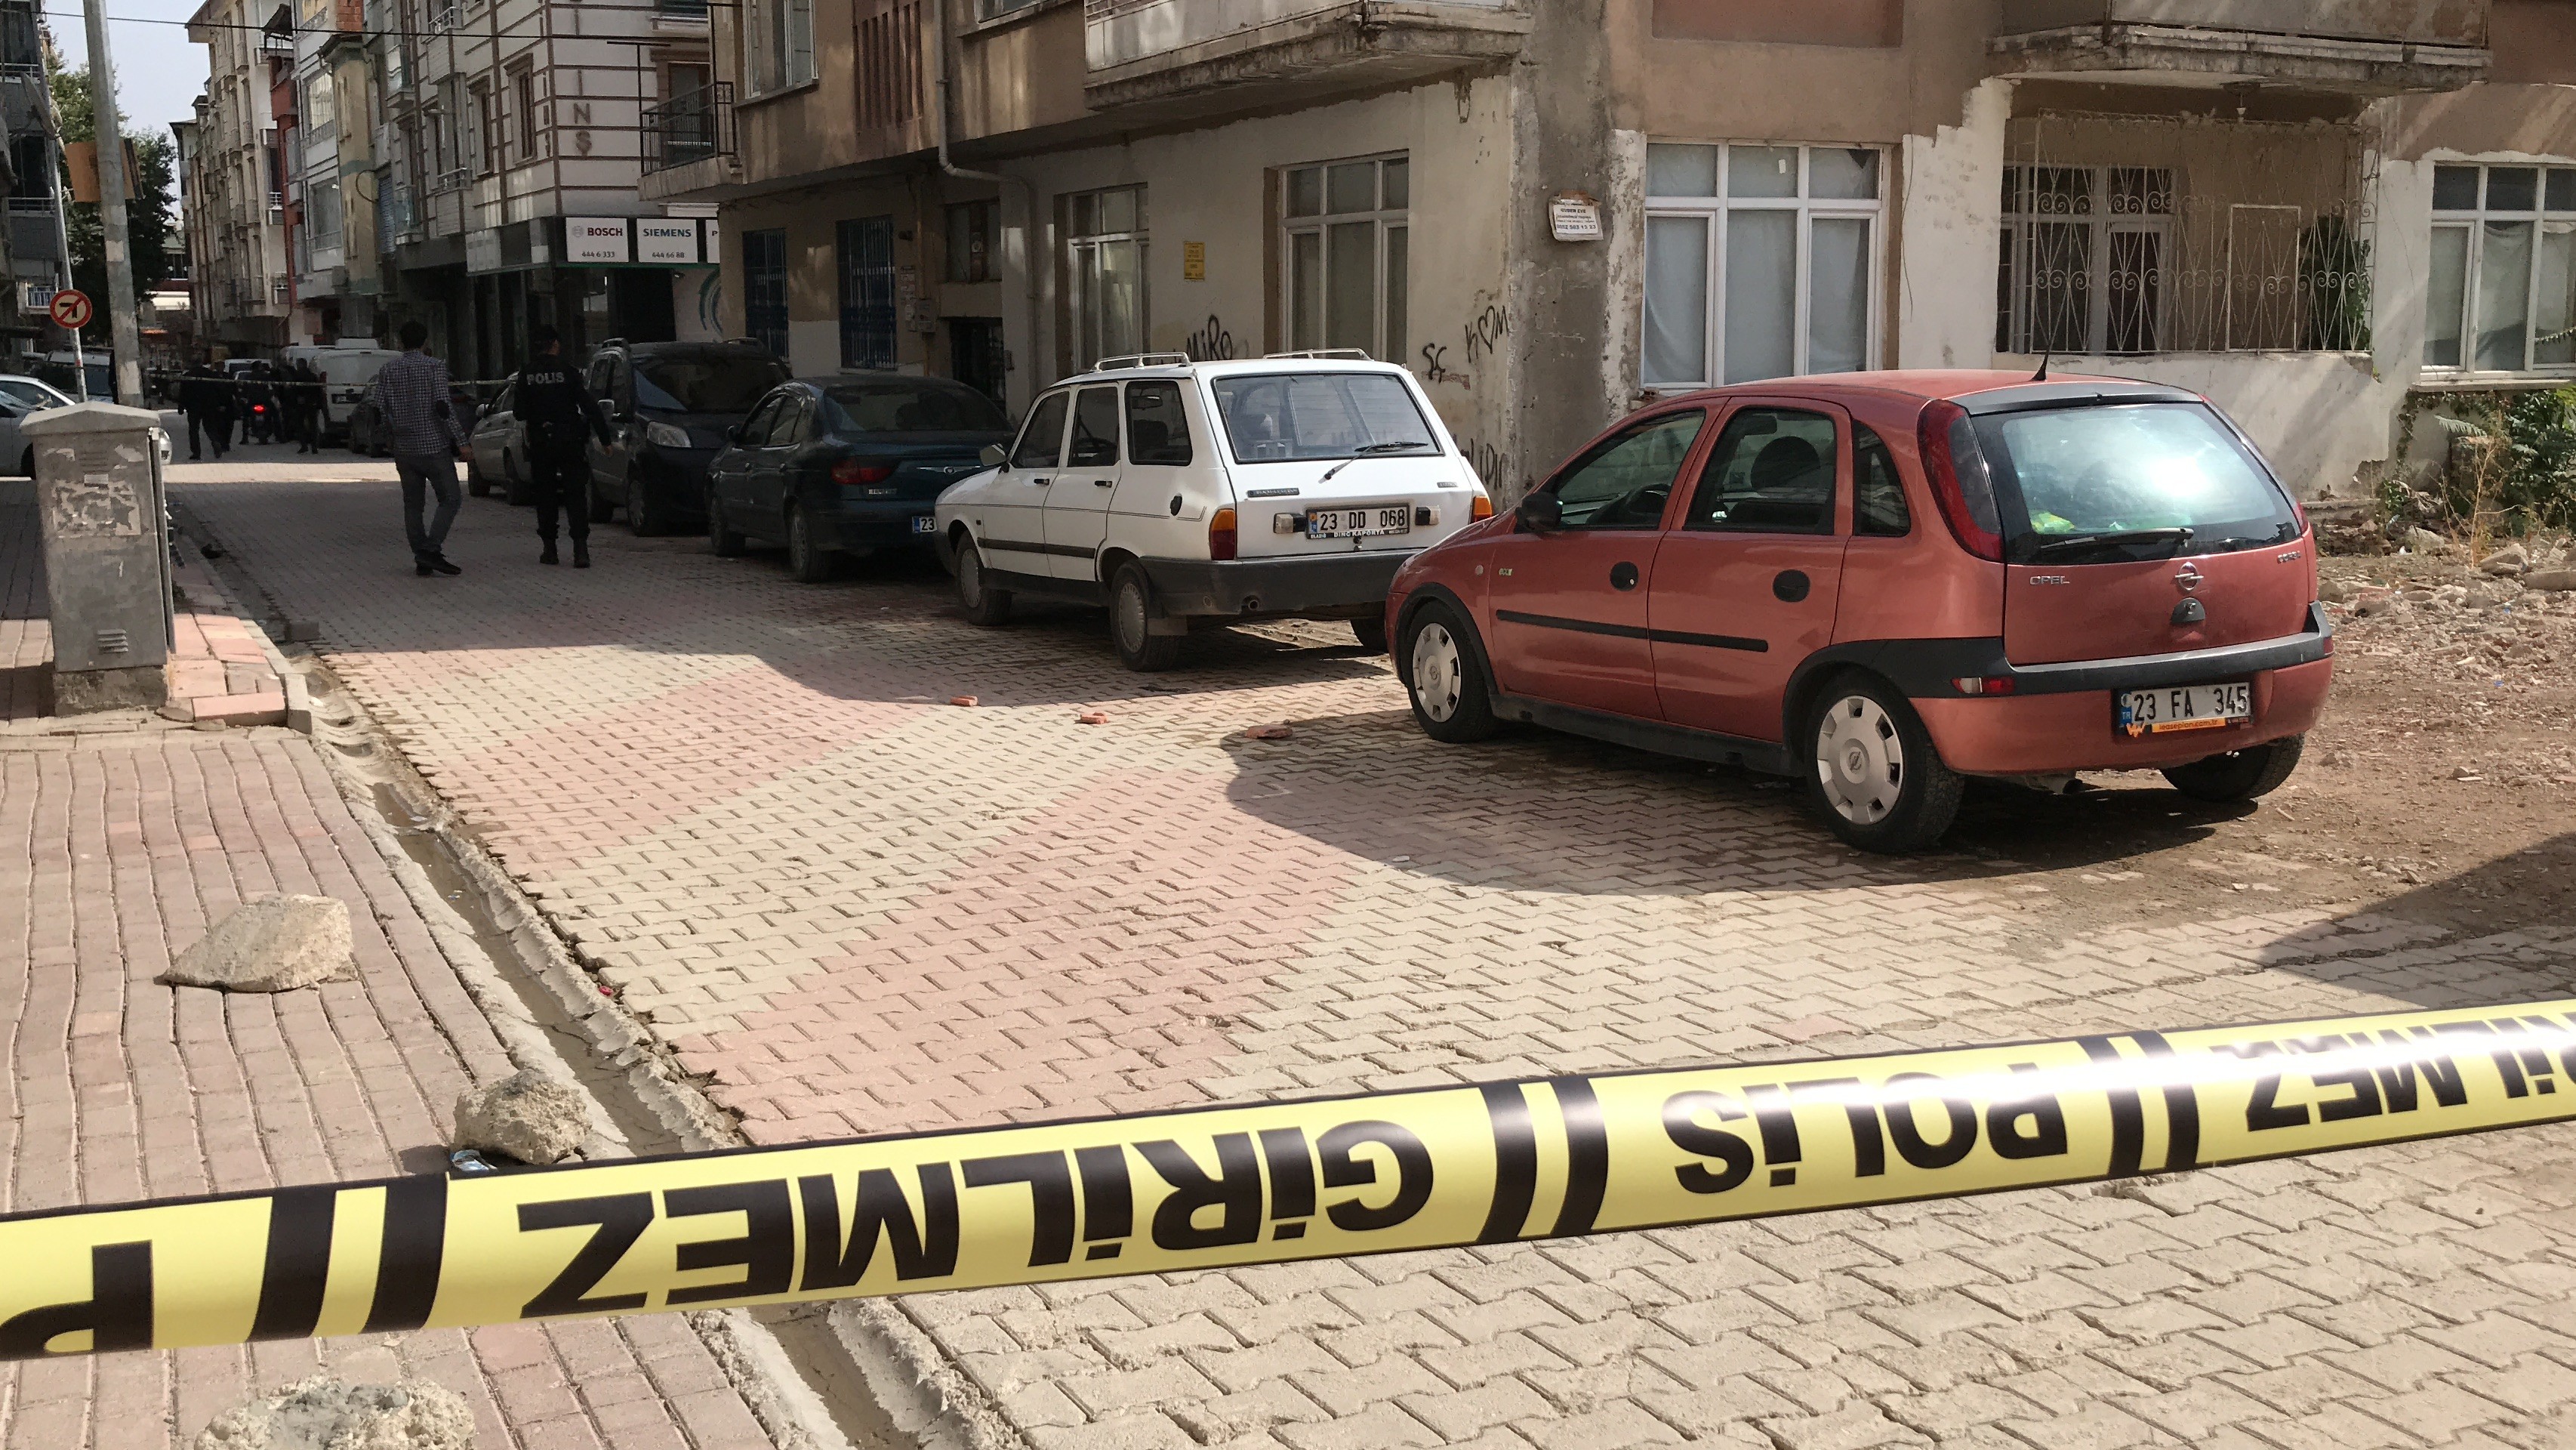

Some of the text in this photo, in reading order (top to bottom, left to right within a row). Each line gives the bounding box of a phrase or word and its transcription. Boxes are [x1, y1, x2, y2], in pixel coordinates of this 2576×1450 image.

[587, 227, 623, 236] BOSCH
[642, 228, 692, 237] SIEMENS
[920, 517, 935, 531] 23
[1320, 513, 1338, 531] 23
[1348, 511, 1366, 529] DD
[1380, 508, 1405, 527] 068
[2029, 575, 2070, 585] OPEL
[2134, 693, 2156, 722] 23
[2171, 690, 2194, 718] FA
[2213, 686, 2248, 715] 345
